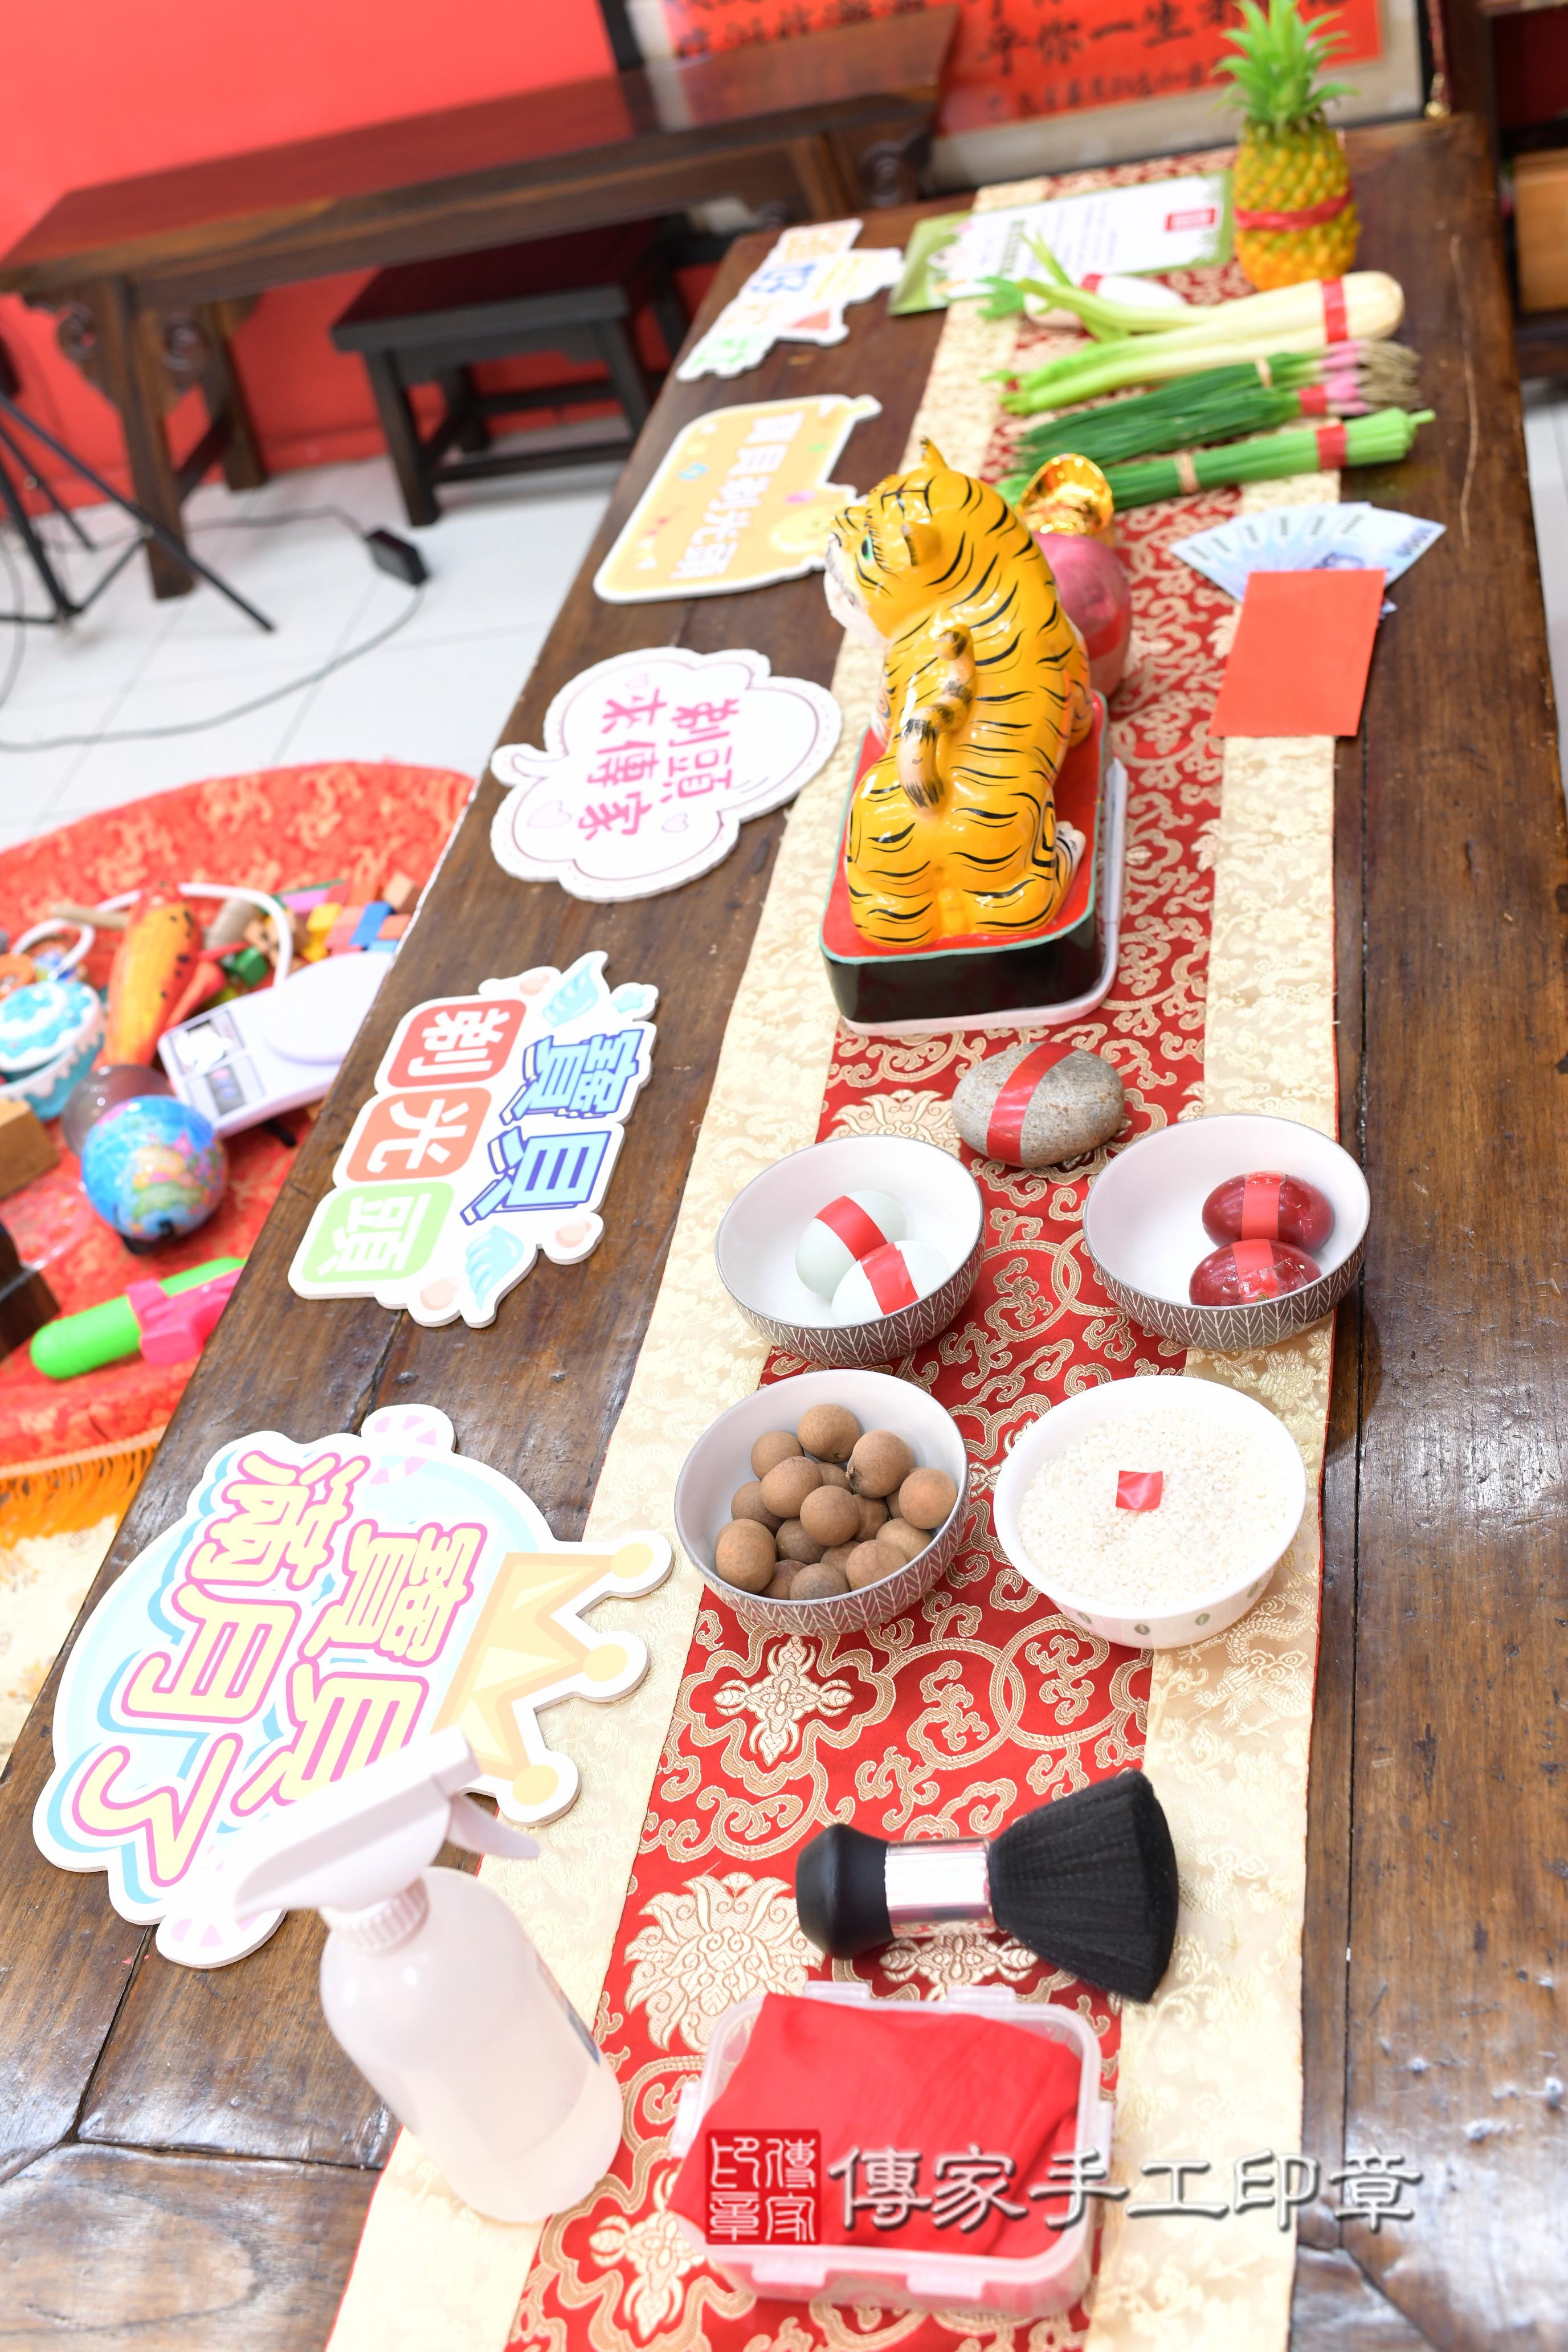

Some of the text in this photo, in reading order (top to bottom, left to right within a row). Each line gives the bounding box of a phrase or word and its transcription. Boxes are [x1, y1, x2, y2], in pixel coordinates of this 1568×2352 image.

[578, 688, 667, 841] 來傳家
[658, 697, 740, 803] 剃頭
[317, 1007, 511, 1277] 剃光頭
[460, 1028, 644, 1226] 寶貝
[72, 1450, 370, 1888] 滿月了
[230, 1518, 488, 1818] 寶貝
